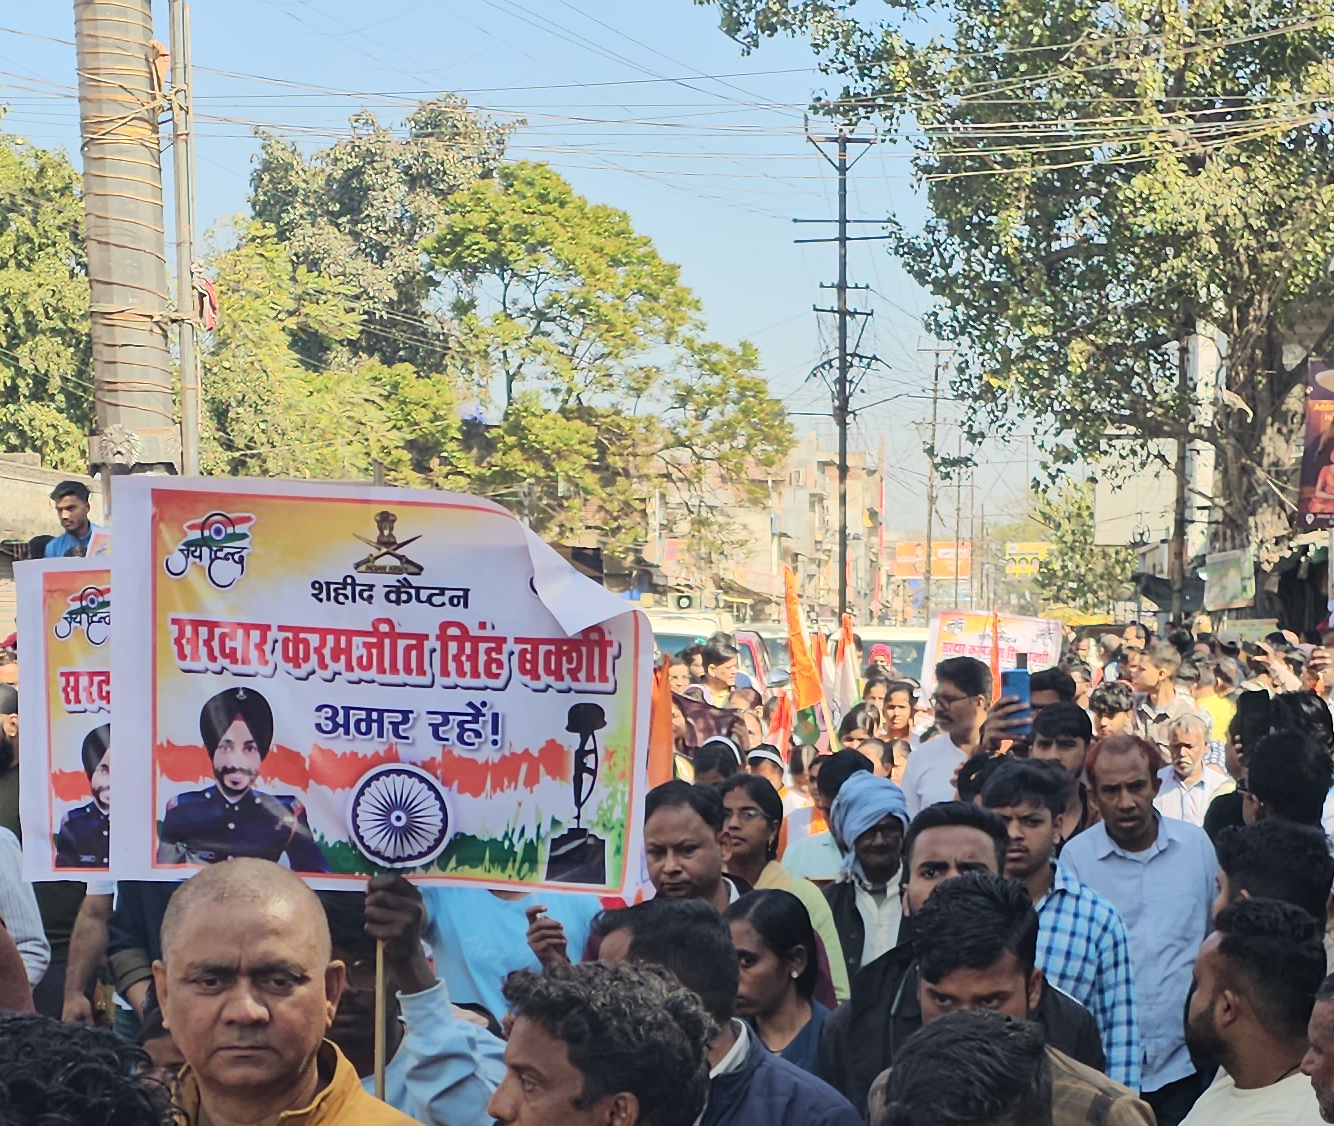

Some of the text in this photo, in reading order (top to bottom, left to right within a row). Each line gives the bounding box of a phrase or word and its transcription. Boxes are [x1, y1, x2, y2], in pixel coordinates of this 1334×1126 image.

[310, 574, 471, 609] शहीद कैप्टन
[170, 616, 615, 685] सरदार करमजीत सिंह बक्शी
[59, 671, 111, 704] सरद
[314, 700, 501, 748] अमर रहें!
